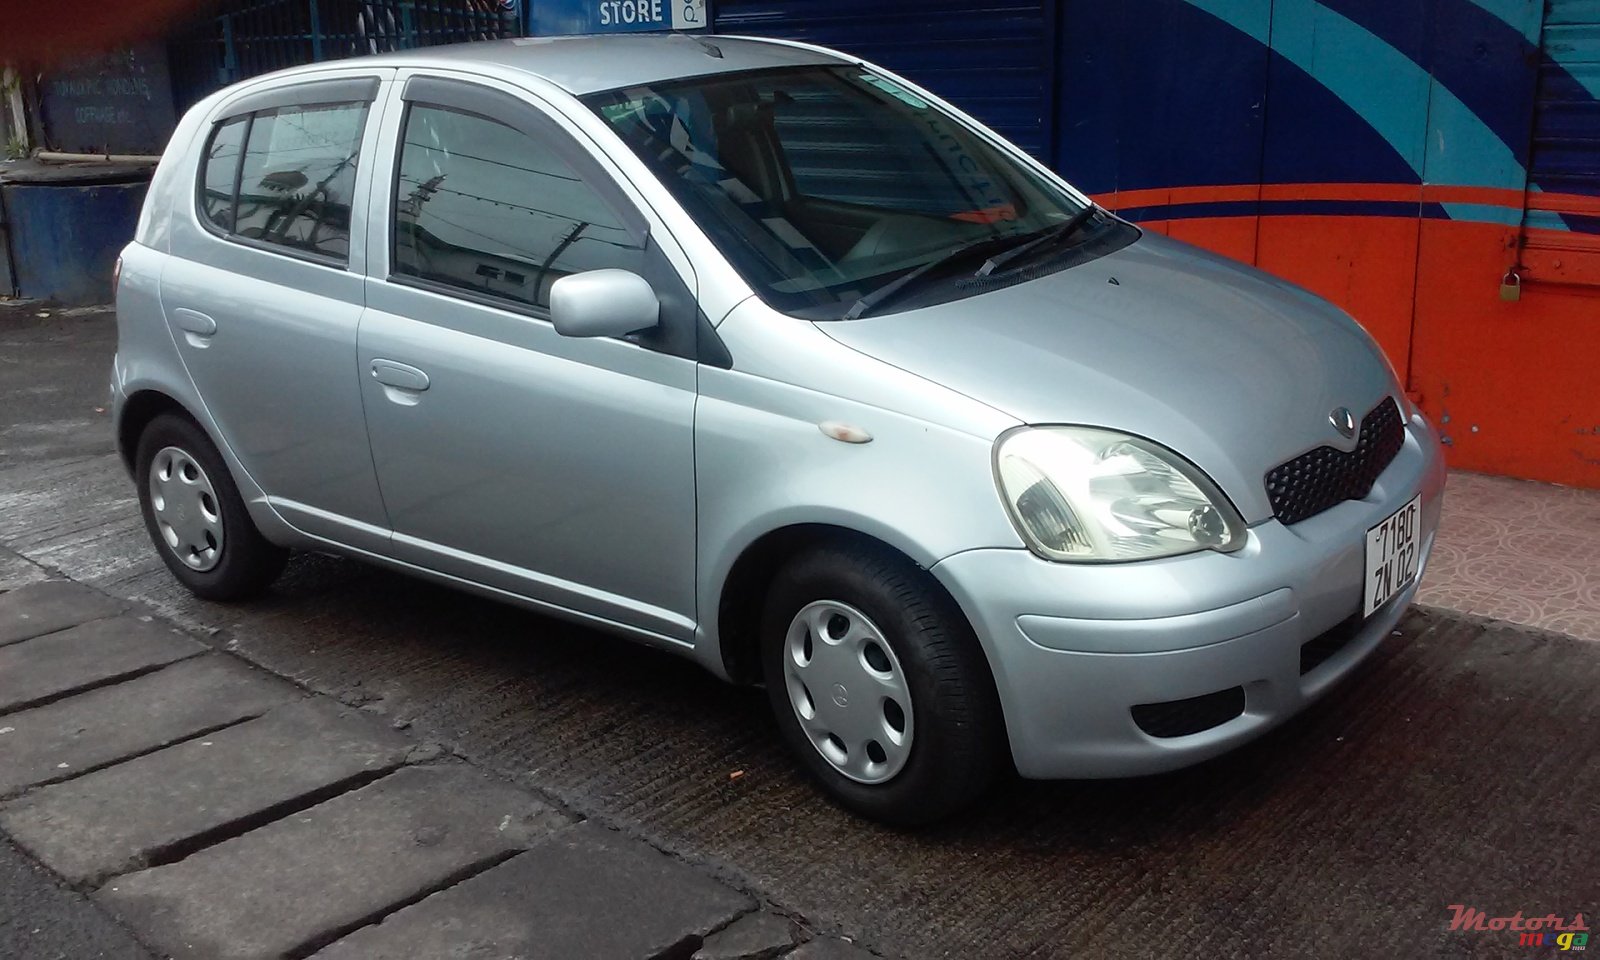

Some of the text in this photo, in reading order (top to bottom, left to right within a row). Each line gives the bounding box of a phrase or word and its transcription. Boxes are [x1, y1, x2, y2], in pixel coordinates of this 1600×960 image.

[600, 0, 663, 25] STORE
[1379, 504, 1414, 562] 7180
[1373, 543, 1414, 609] ZN 02
